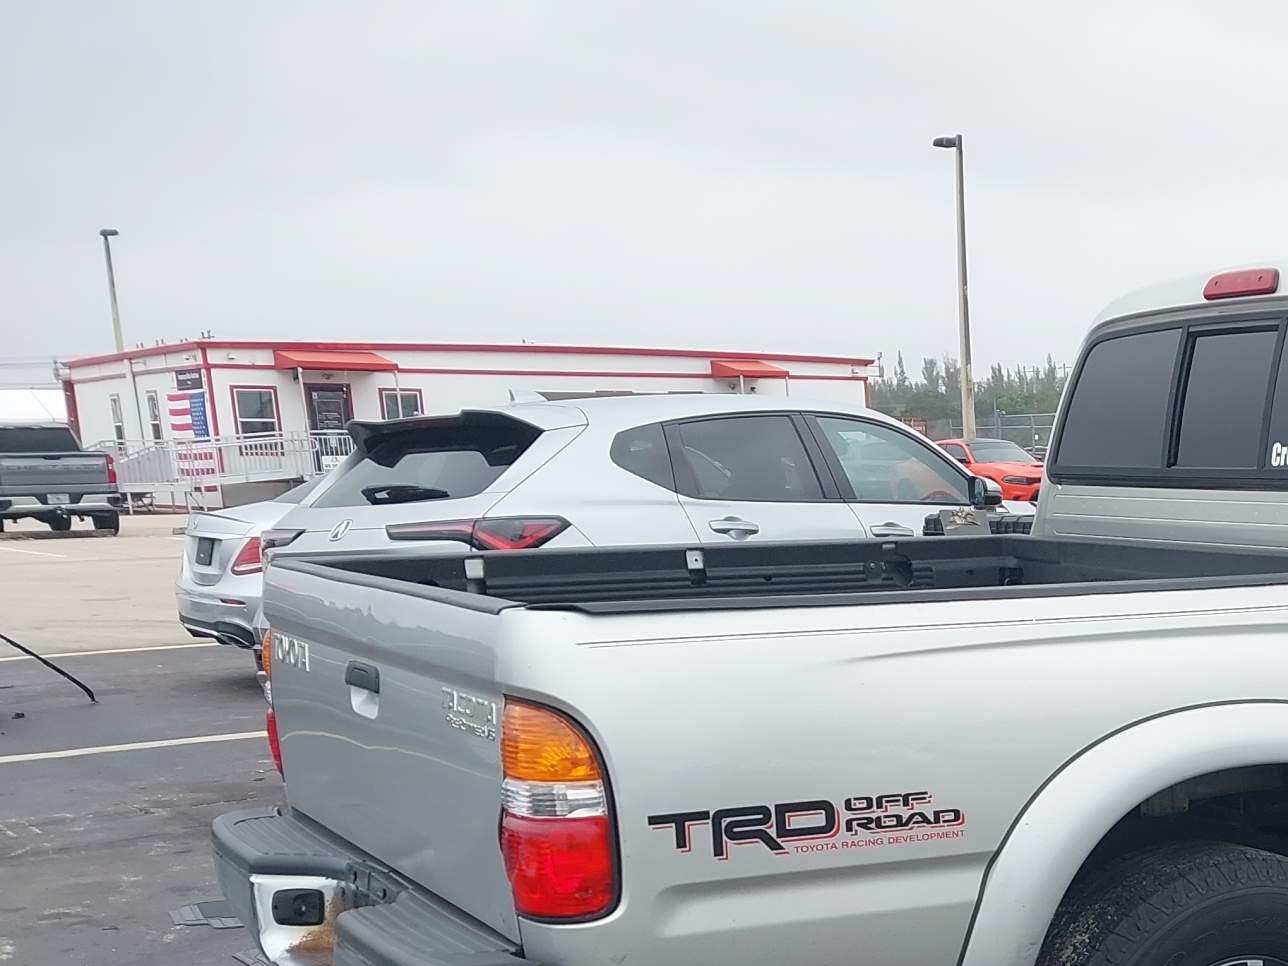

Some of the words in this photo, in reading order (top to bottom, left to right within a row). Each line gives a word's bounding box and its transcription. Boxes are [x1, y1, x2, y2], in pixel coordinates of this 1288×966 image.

[844, 791, 932, 814] OFF
[647, 799, 841, 861] TRD
[845, 809, 965, 836] ROAD
[794, 841, 838, 853] TOYOTA
[841, 838, 884, 849] RACING
[888, 830, 966, 845] DEVELOPMENT
